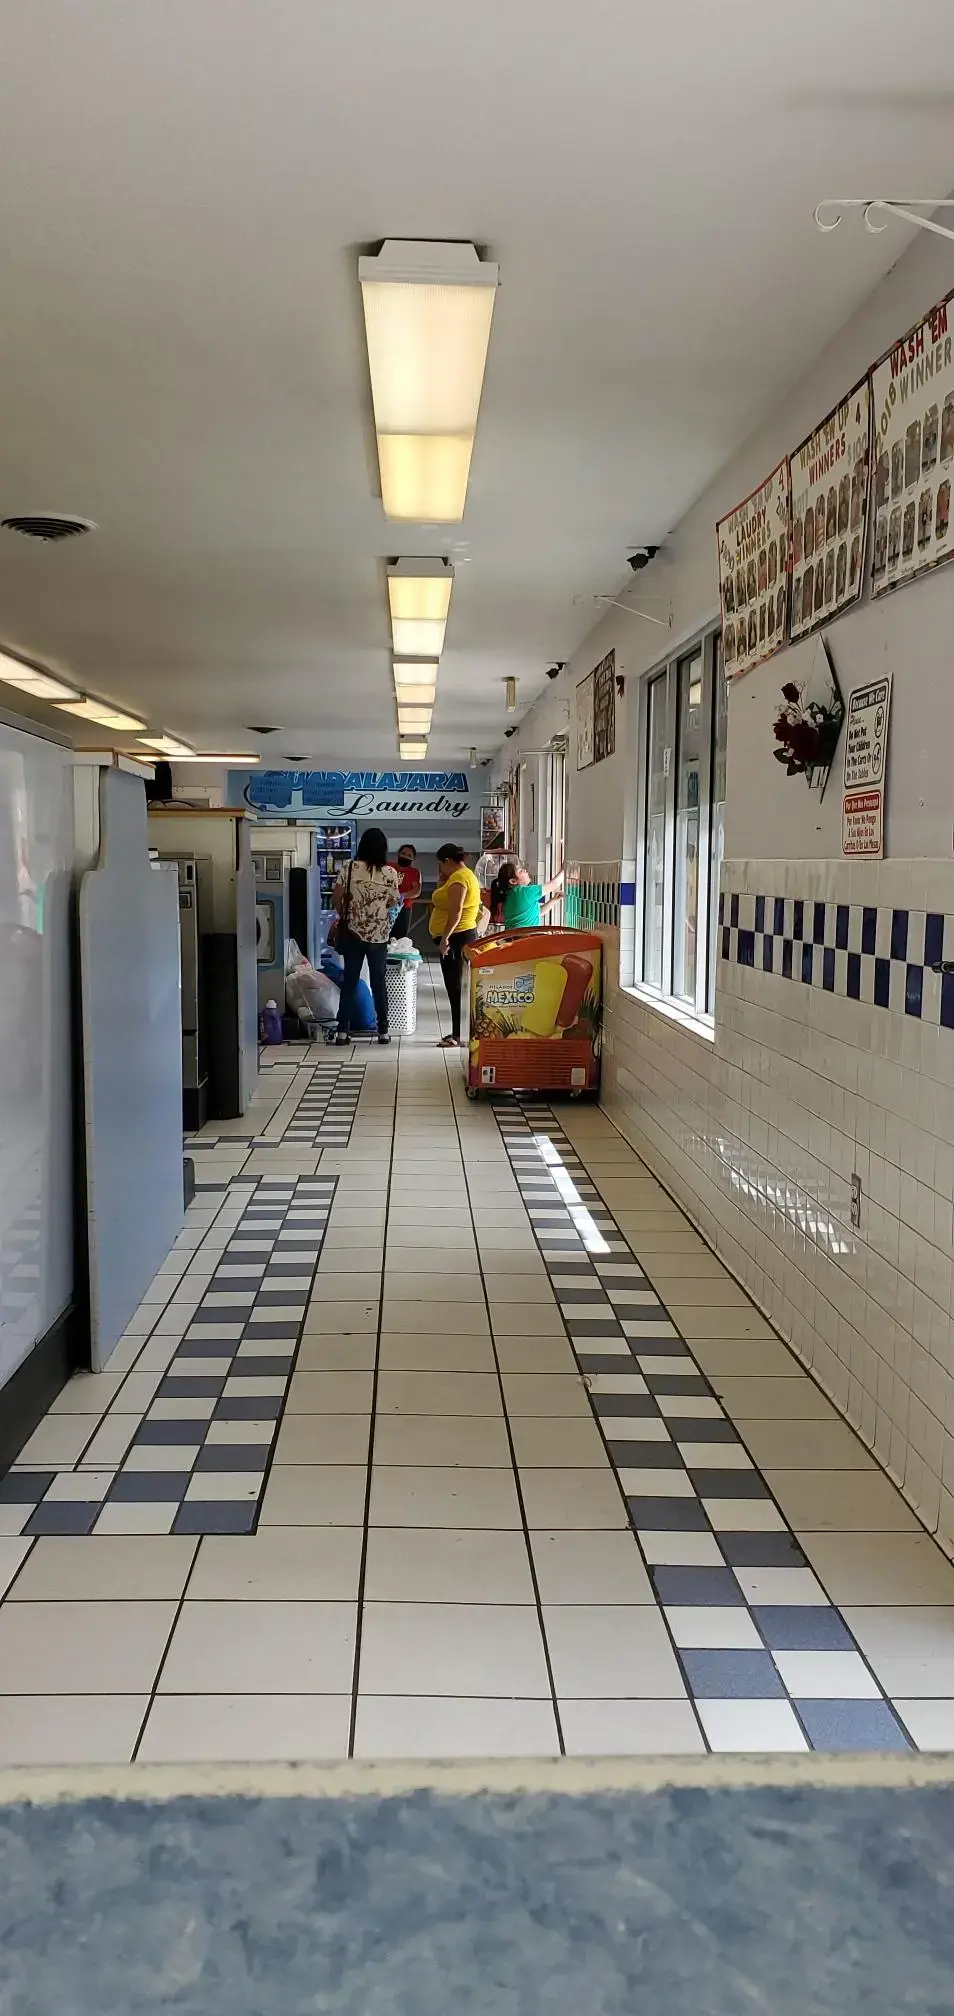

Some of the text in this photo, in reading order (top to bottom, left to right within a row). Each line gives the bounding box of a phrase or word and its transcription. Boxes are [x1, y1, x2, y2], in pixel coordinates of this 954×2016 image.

[889, 325, 924, 380] WASH
[800, 431, 820, 471] WASH
[837, 402, 850, 433] UP
[808, 432, 846, 487] WINNERS
[736, 505, 767, 548] LAUDRY
[327, 794, 471, 817] Laundry
[487, 990, 535, 1004] MEXICO
